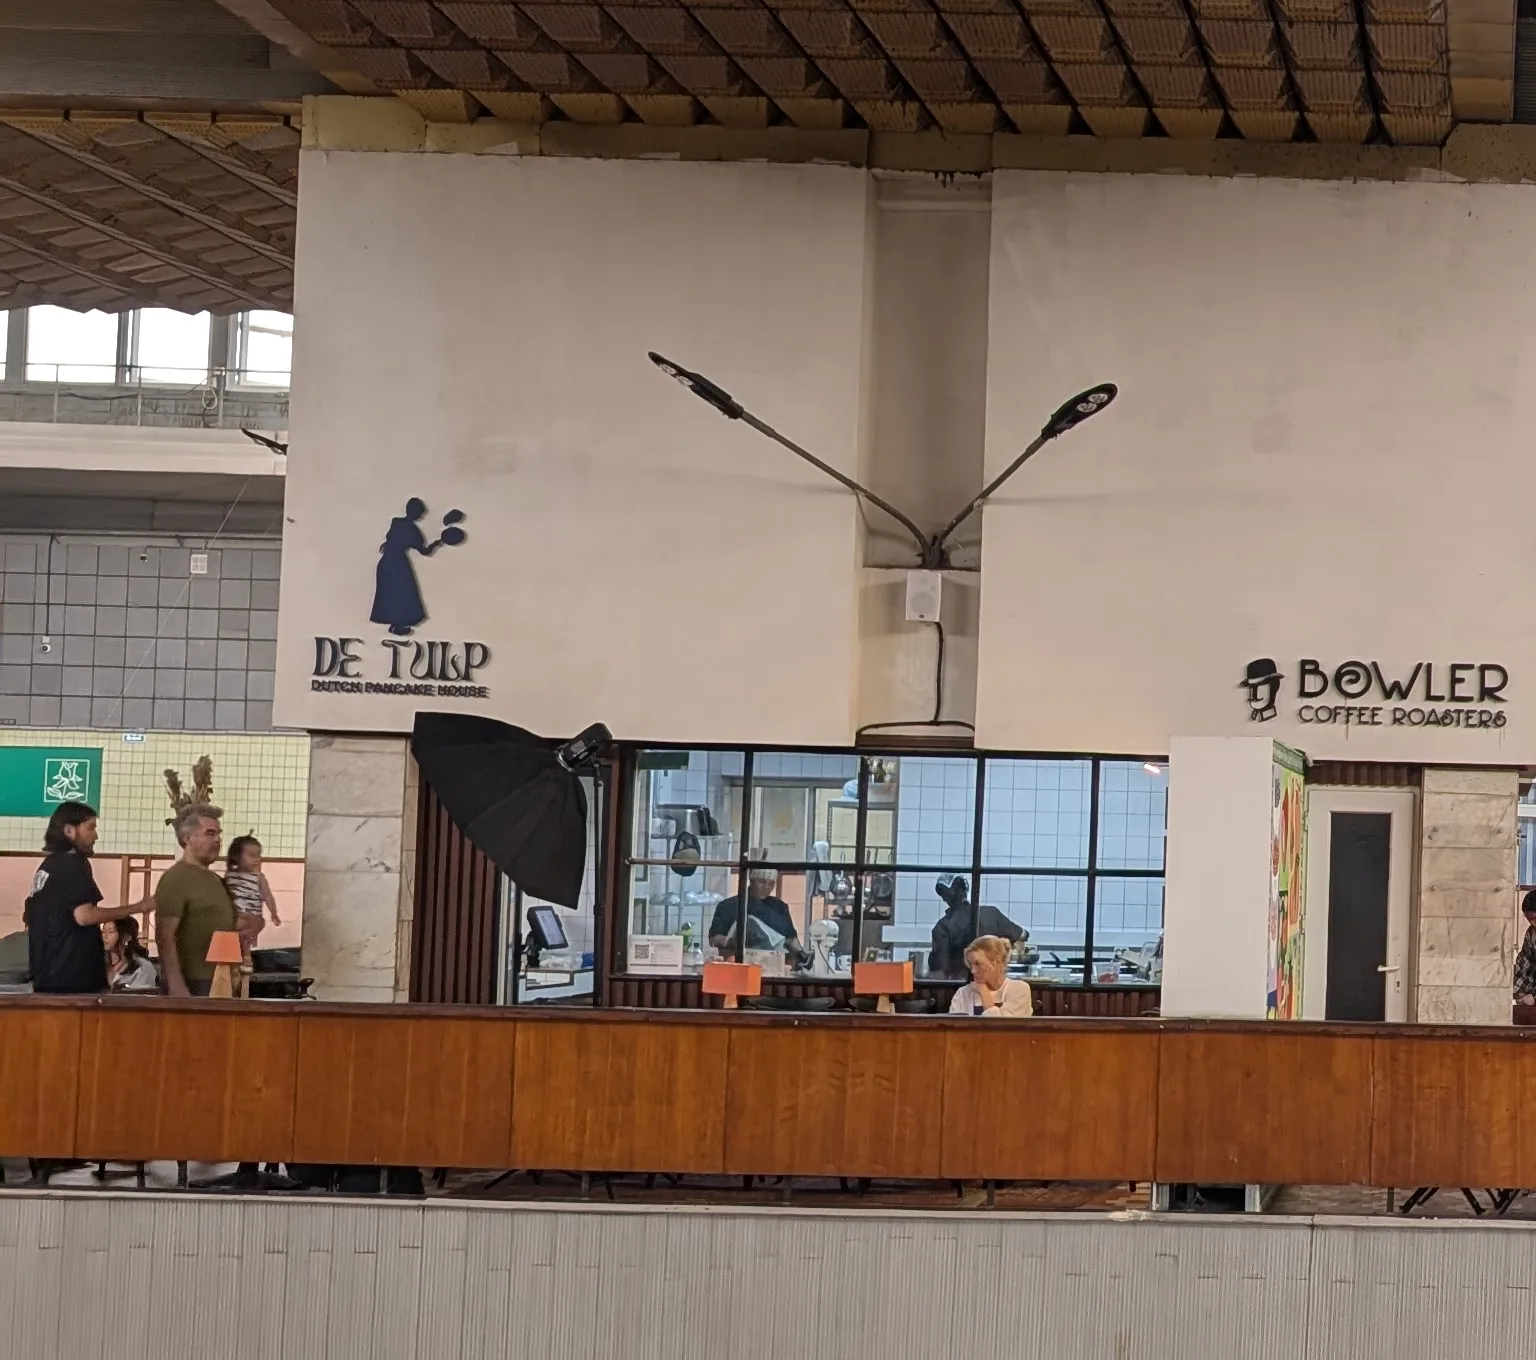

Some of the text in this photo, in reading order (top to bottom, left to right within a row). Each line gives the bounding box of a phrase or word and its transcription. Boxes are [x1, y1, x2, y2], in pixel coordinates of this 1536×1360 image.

[312, 636, 492, 682] DE TULP
[311, 679, 491, 698] DUTCH PANCAKE HOUSE
[1298, 659, 1509, 703] BOWLER
[1299, 705, 1508, 728] COFFEE ROASTERS
